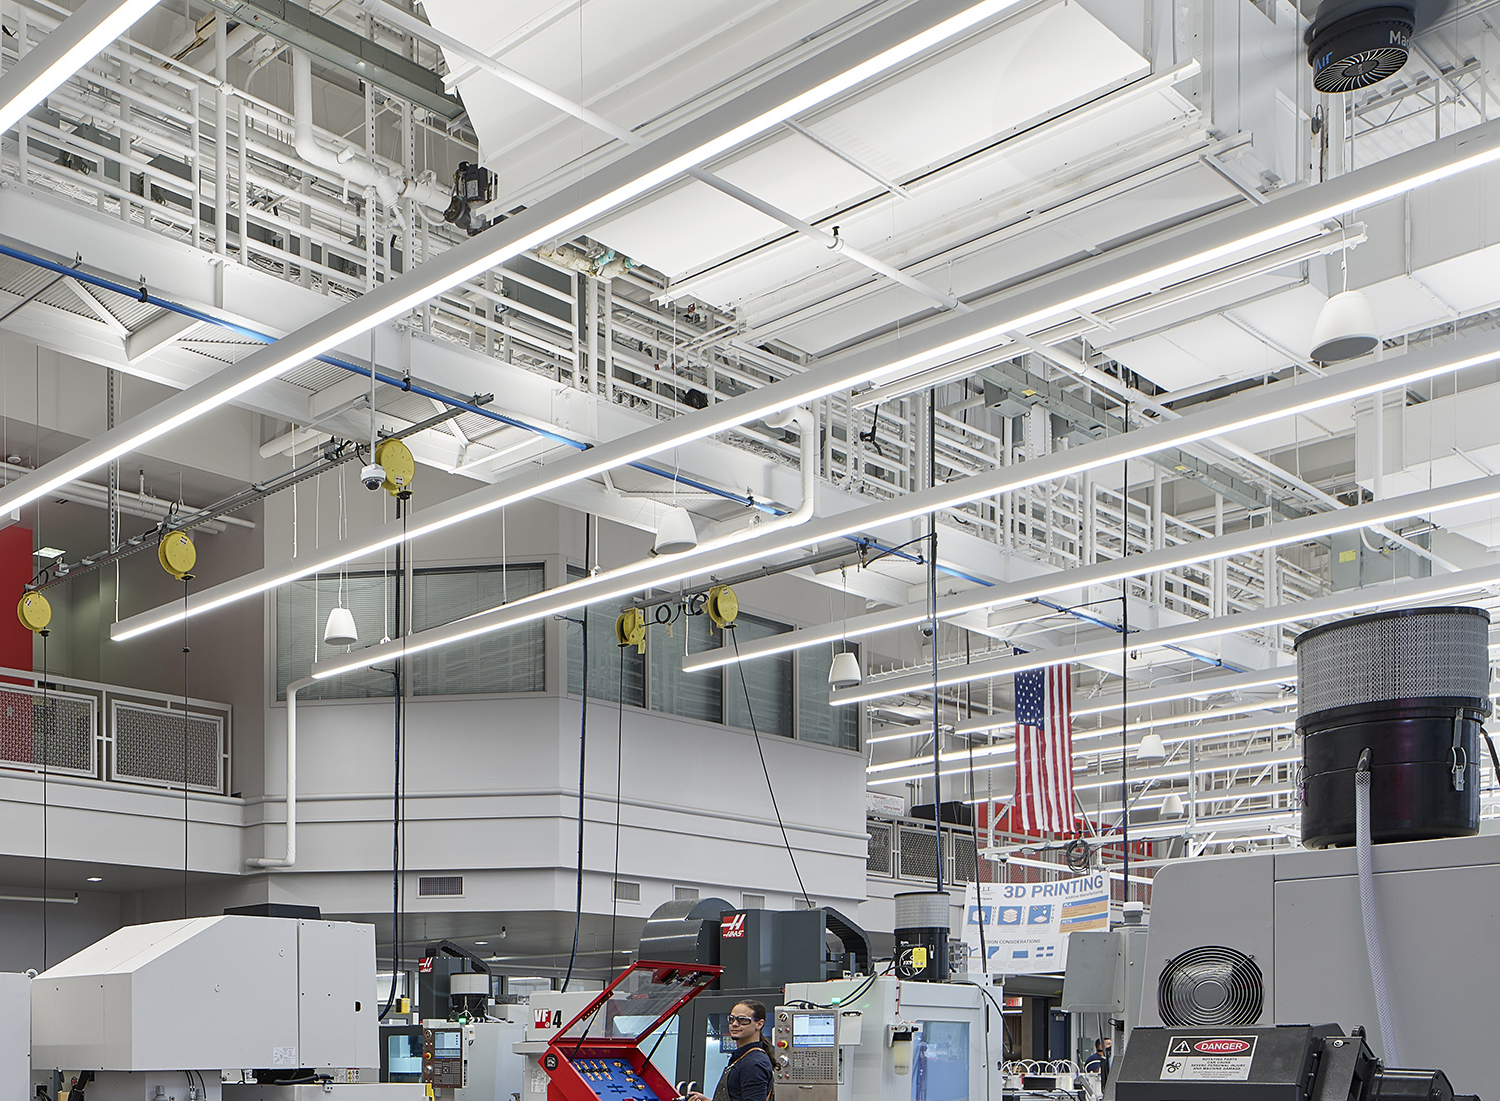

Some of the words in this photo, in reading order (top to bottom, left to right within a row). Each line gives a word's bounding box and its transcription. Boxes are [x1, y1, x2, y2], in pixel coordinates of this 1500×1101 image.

[1003, 885, 1027, 899] 3D
[1031, 874, 1103, 898] PRINTING
[1007, 998, 1019, 1007] EXIT
[533, 1008, 550, 1023] VF
[552, 1009, 563, 1029] 4
[1200, 1042, 1243, 1050] DANGER
